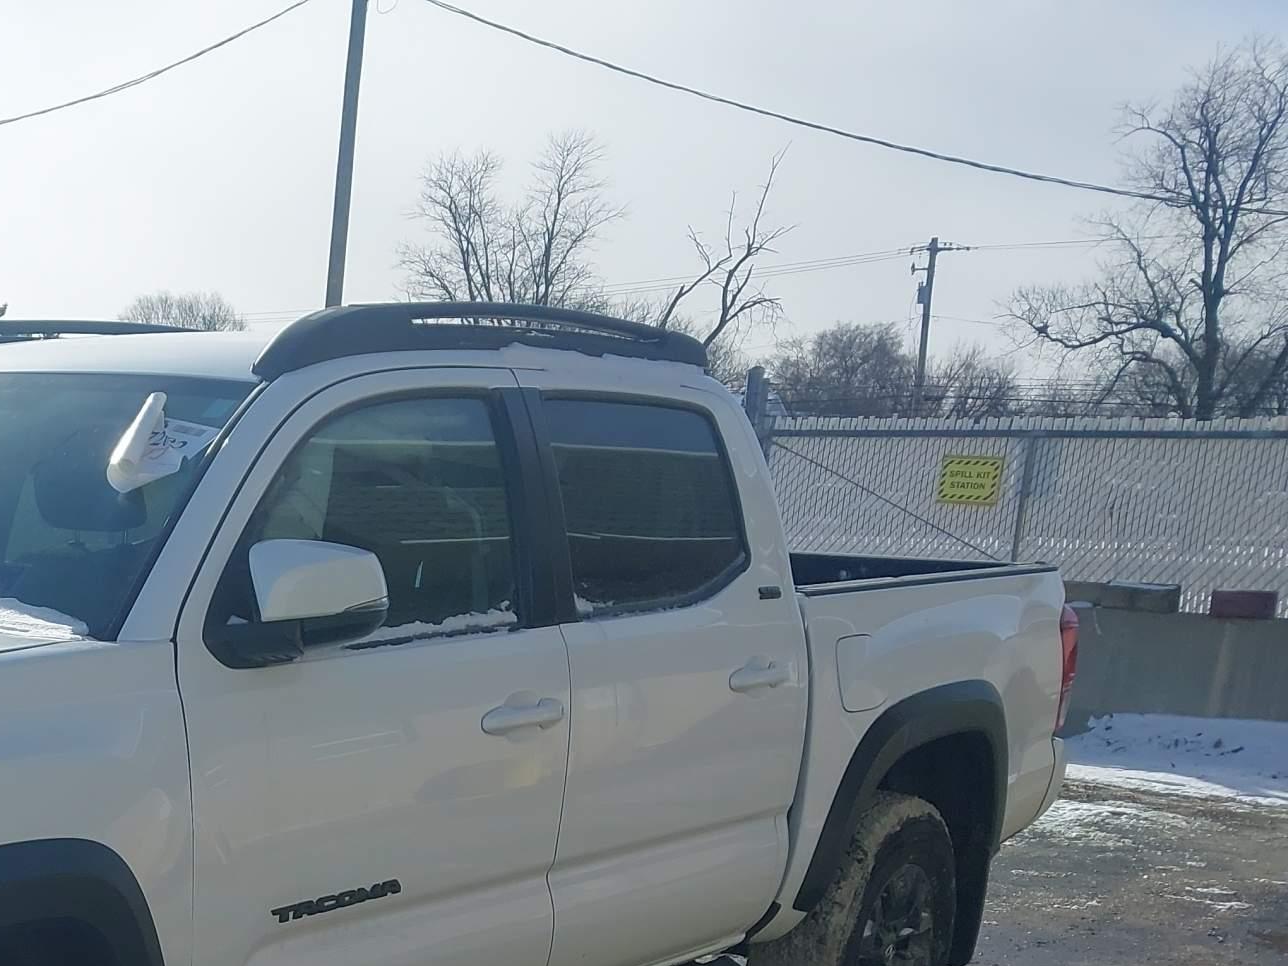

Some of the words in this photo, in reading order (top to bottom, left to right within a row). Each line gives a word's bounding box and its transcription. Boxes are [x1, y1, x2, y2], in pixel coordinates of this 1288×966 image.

[949, 471, 973, 479] SPILL
[949, 482, 985, 490] STATION
[270, 879, 402, 923] TACOMA
